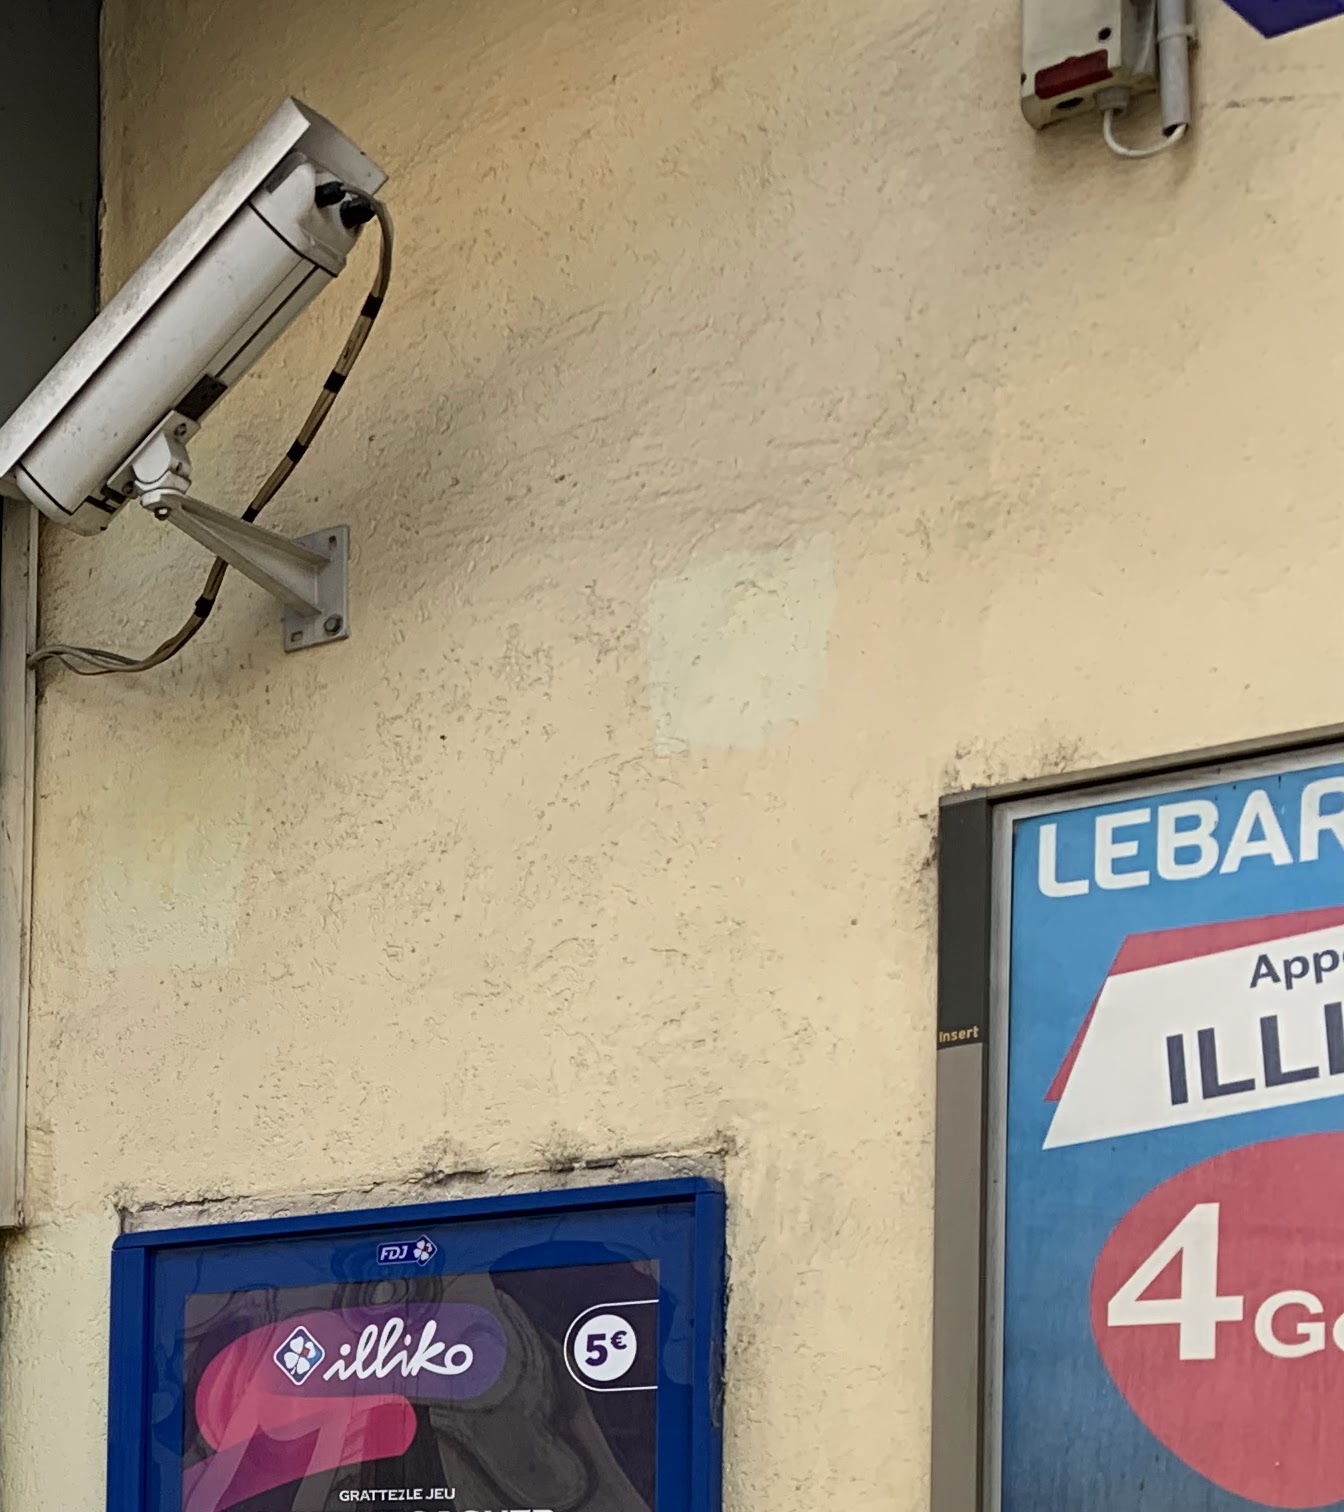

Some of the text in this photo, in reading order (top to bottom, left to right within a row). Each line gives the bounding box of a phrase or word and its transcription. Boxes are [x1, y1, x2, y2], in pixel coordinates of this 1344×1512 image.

[1250, 948, 1344, 991] App
[379, 1244, 409, 1261] FDJ
[1107, 1202, 1244, 1361] 4
[322, 1317, 629, 1382] illiko 5€
[339, 1488, 456, 1502] GRATTEZ LE JEU
